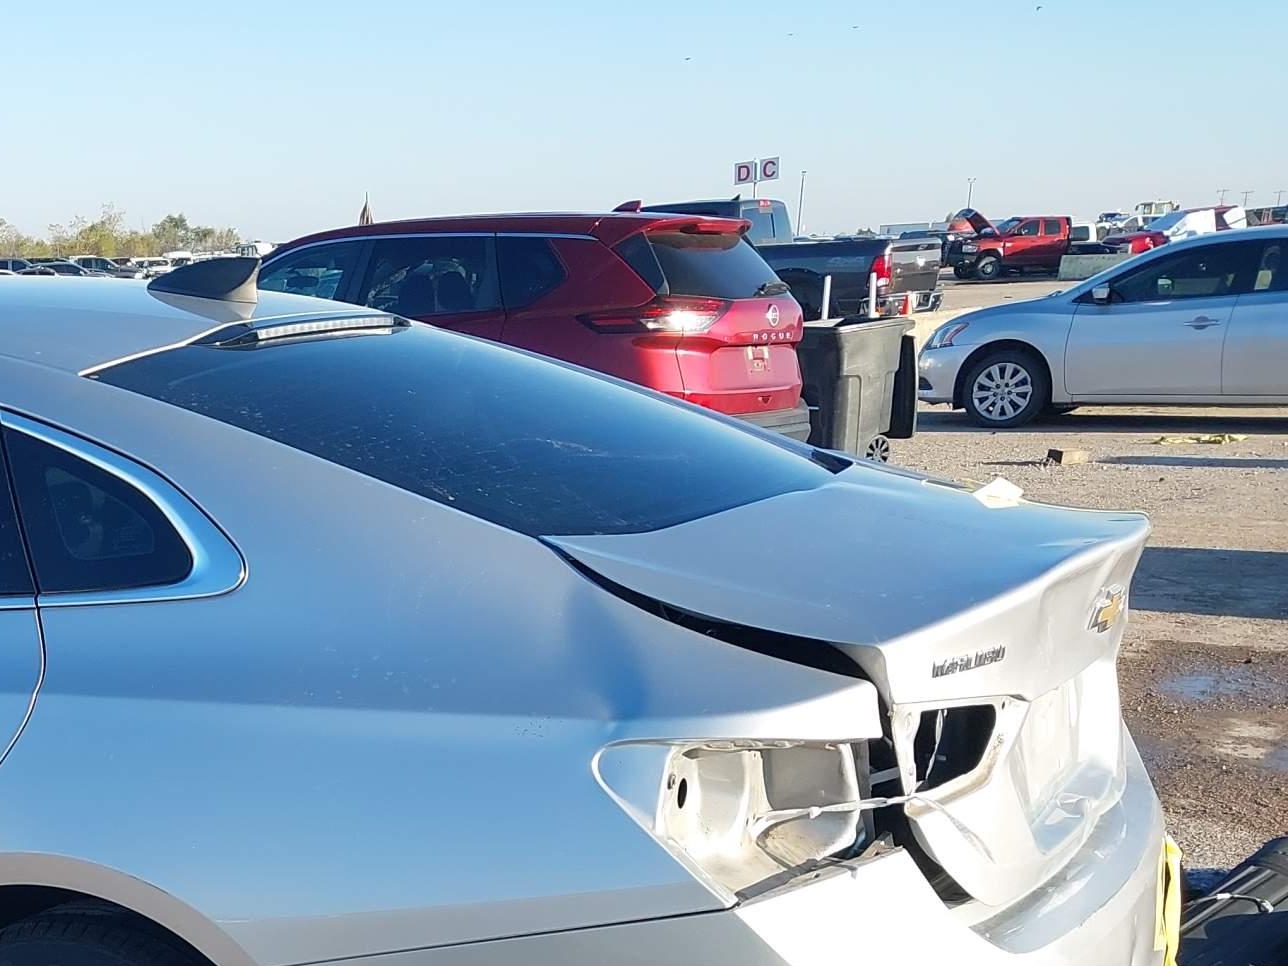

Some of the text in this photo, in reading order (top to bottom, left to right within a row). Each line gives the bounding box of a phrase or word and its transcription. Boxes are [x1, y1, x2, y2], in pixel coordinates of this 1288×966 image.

[738, 165, 750, 182] D
[763, 160, 777, 178] C
[753, 332, 791, 341] ROGUE
